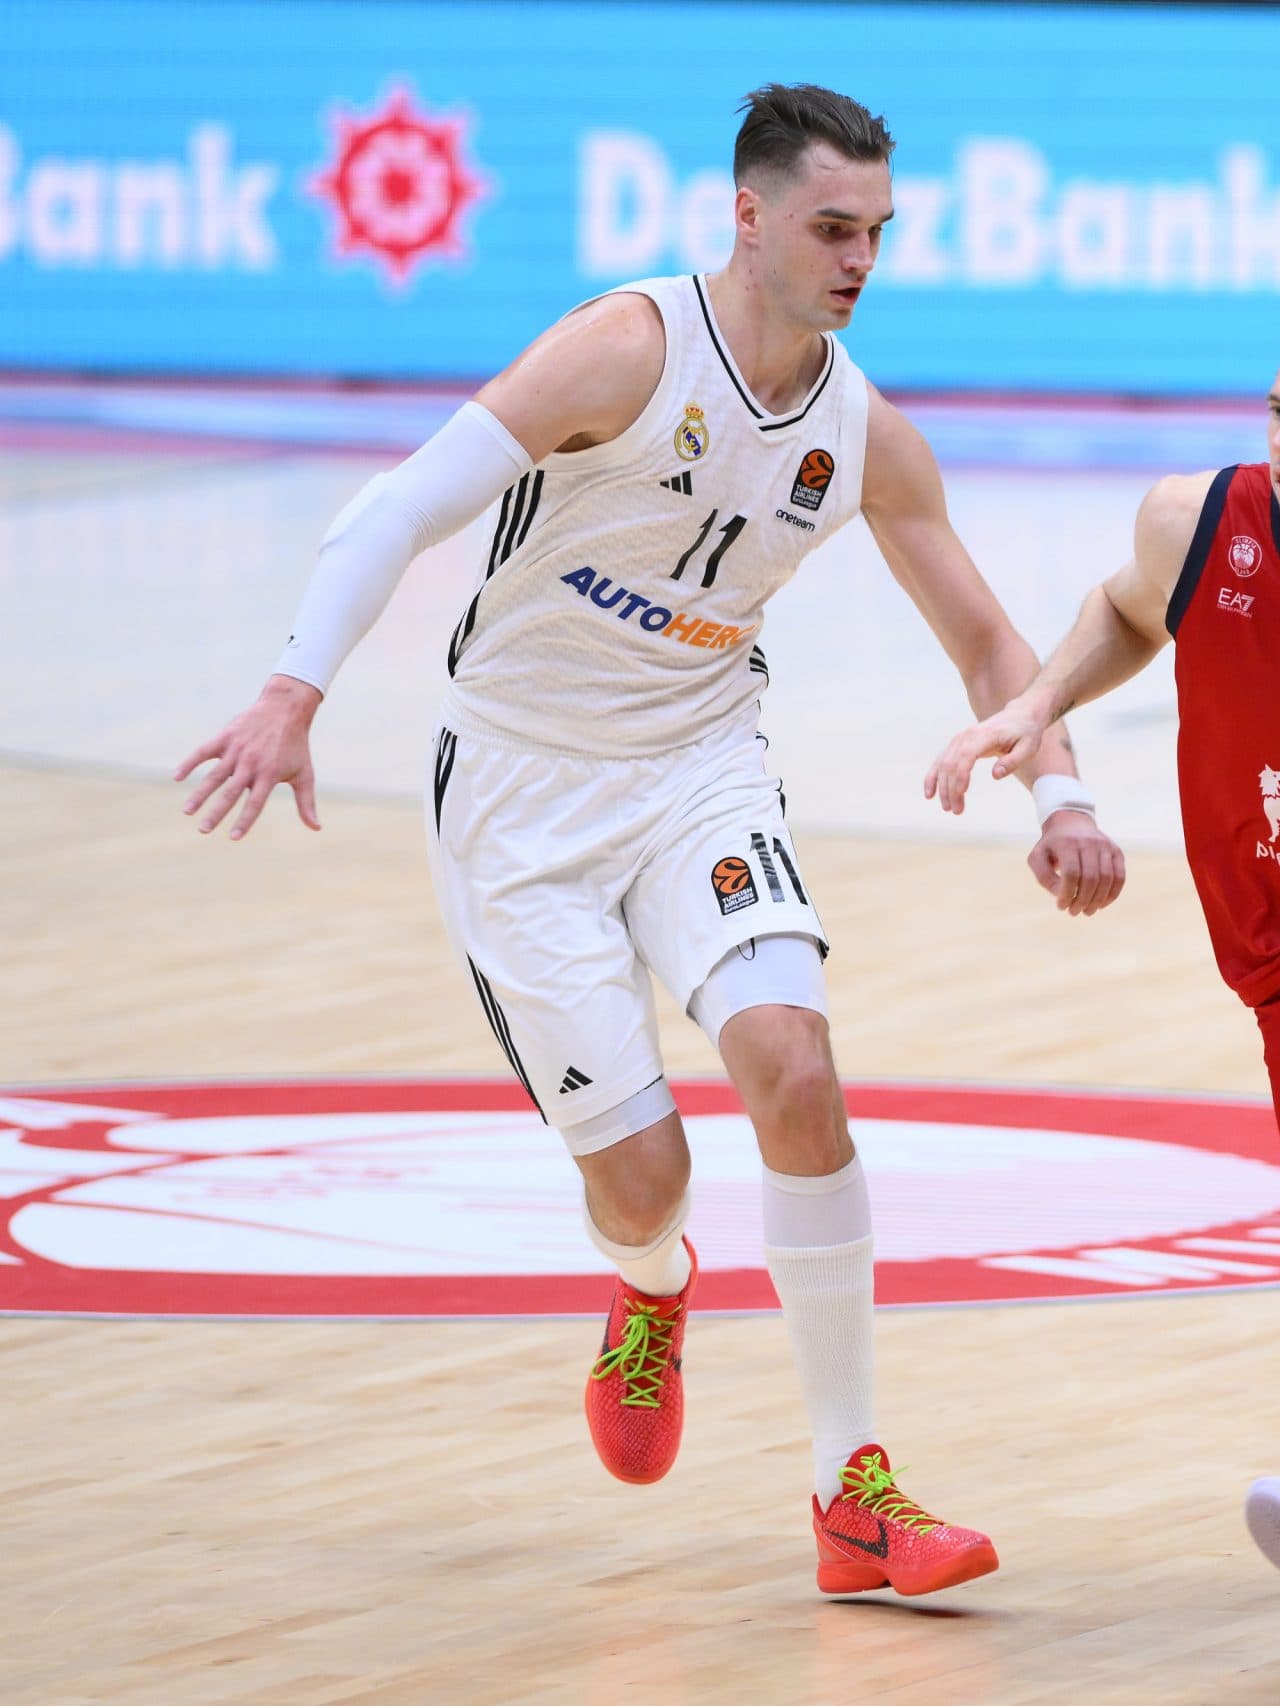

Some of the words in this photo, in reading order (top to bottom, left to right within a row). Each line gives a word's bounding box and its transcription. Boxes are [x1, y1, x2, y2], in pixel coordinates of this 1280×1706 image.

[0, 123, 277, 270] ank
[776, 509, 815, 532] oneteam
[670, 508, 747, 588] 11
[1218, 587, 1255, 612] EA7
[750, 832, 809, 906] 11
[721, 886, 753, 905] TURKISH
